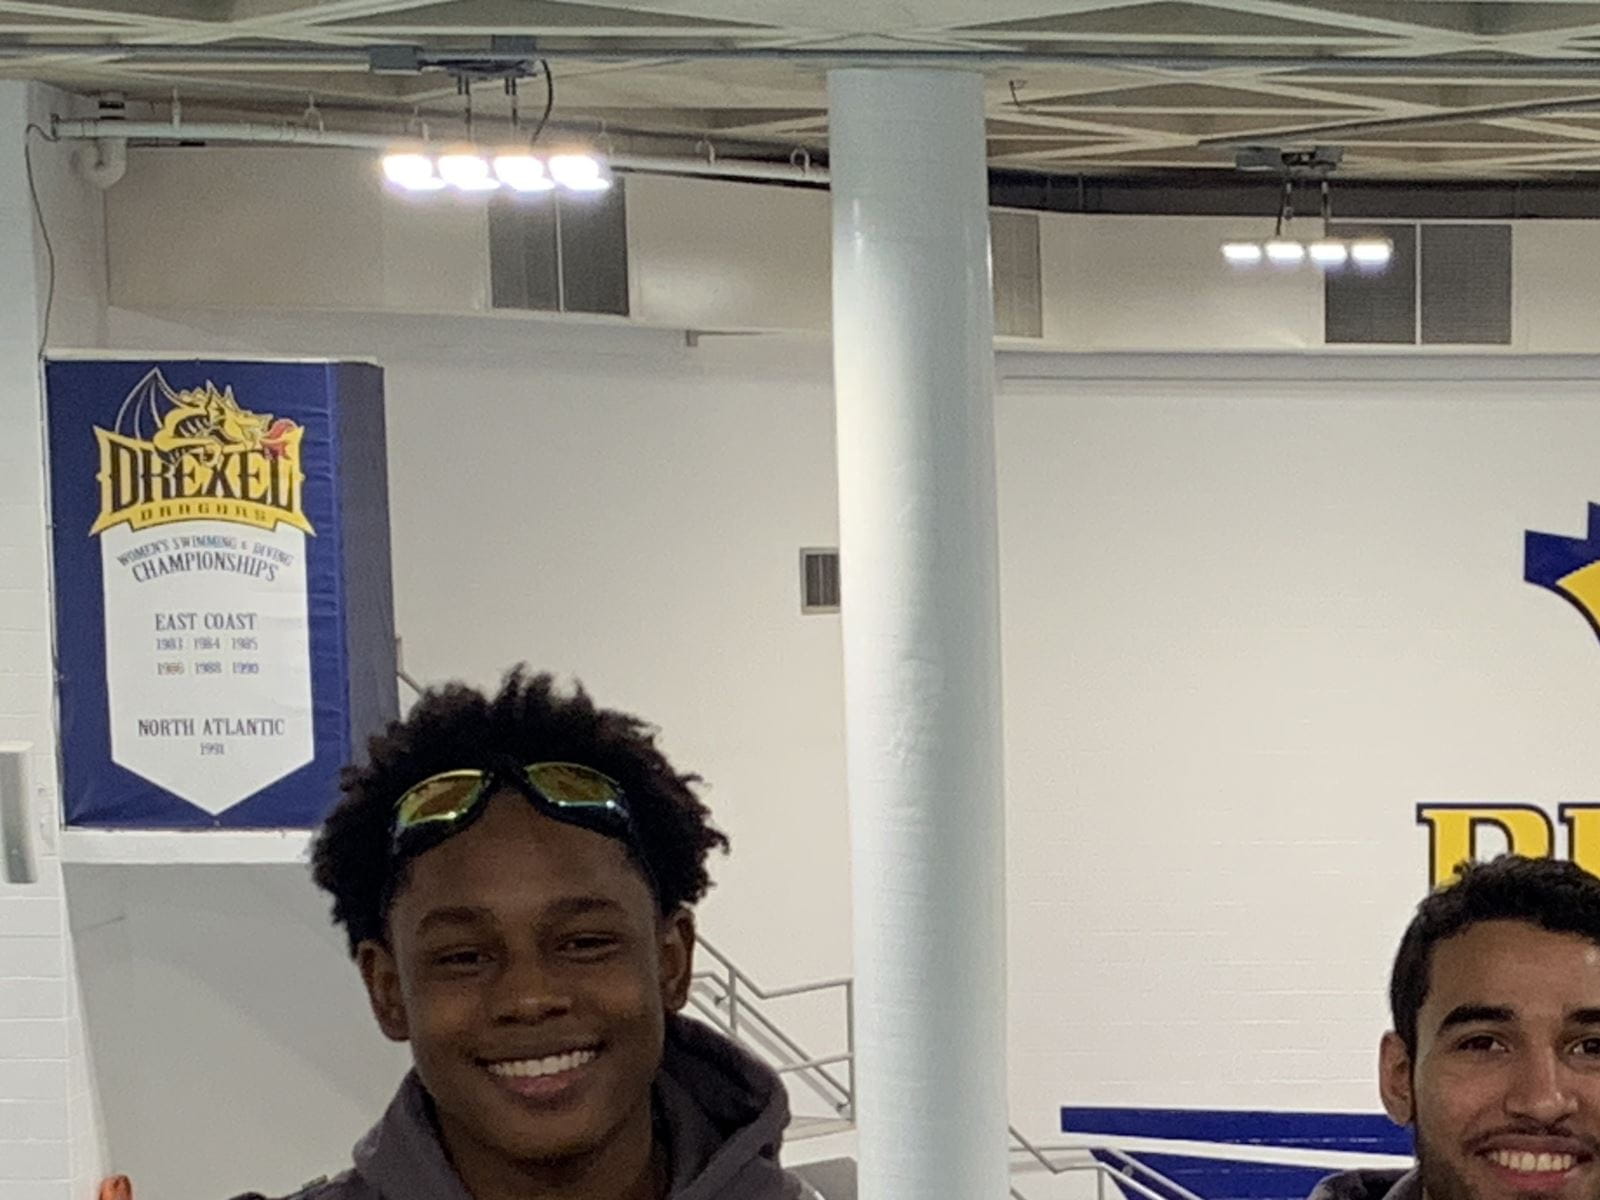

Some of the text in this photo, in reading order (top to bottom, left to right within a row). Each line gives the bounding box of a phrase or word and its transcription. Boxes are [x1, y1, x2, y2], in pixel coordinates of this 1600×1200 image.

[108, 439, 294, 514] DREXEL
[140, 502, 266, 522] DRAGONS
[116, 538, 170, 567] WOMEN'S
[171, 534, 237, 551] SWIMMING
[252, 542, 295, 567] DIVING
[131, 550, 280, 583] CHAMPIONSHIPS
[154, 612, 258, 631] EAST COAST
[137, 717, 286, 737] NORTH ATLANTIC
